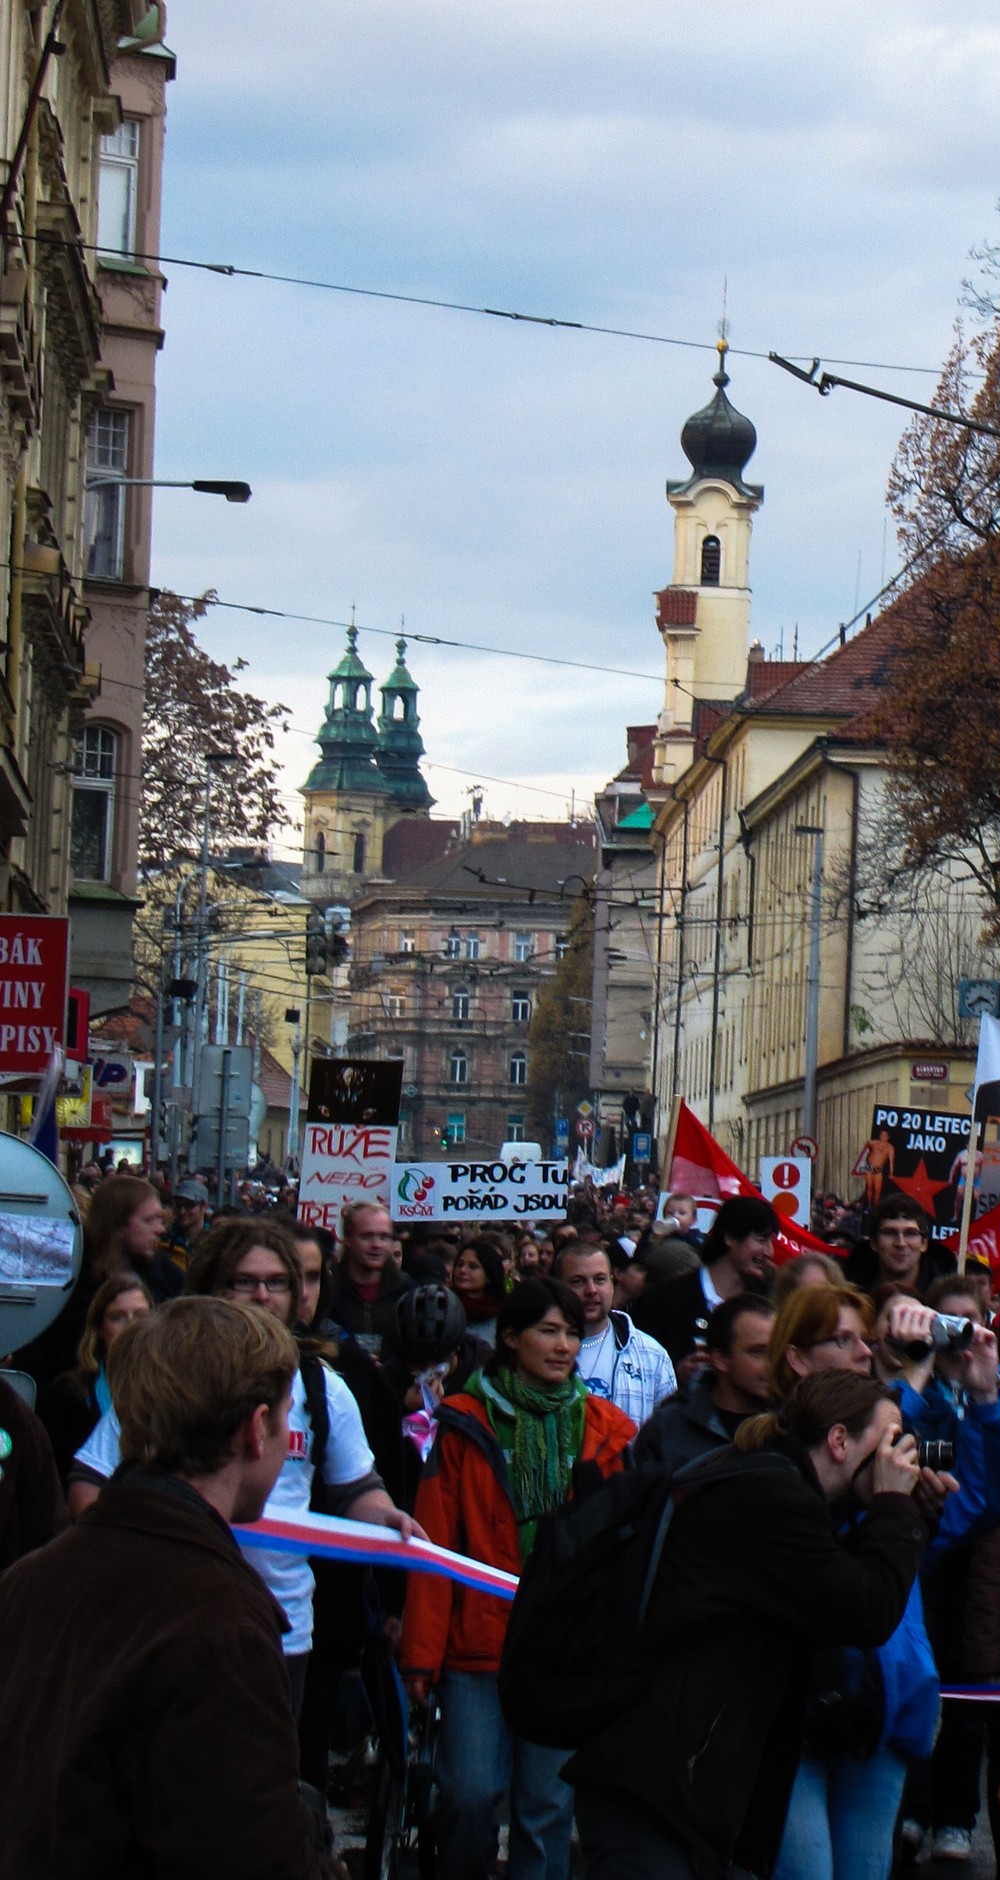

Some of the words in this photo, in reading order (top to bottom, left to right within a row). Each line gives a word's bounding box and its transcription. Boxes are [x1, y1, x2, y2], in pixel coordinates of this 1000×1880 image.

[0, 981, 45, 1008] INY
[876, 1109, 898, 1127] PO
[901, 1112, 922, 1130] 20
[906, 1133, 946, 1152] JAKO
[399, 1202, 433, 1216] KSČM
[443, 1187, 509, 1211] POŘÁD
[932, 1225, 959, 1240] LET
